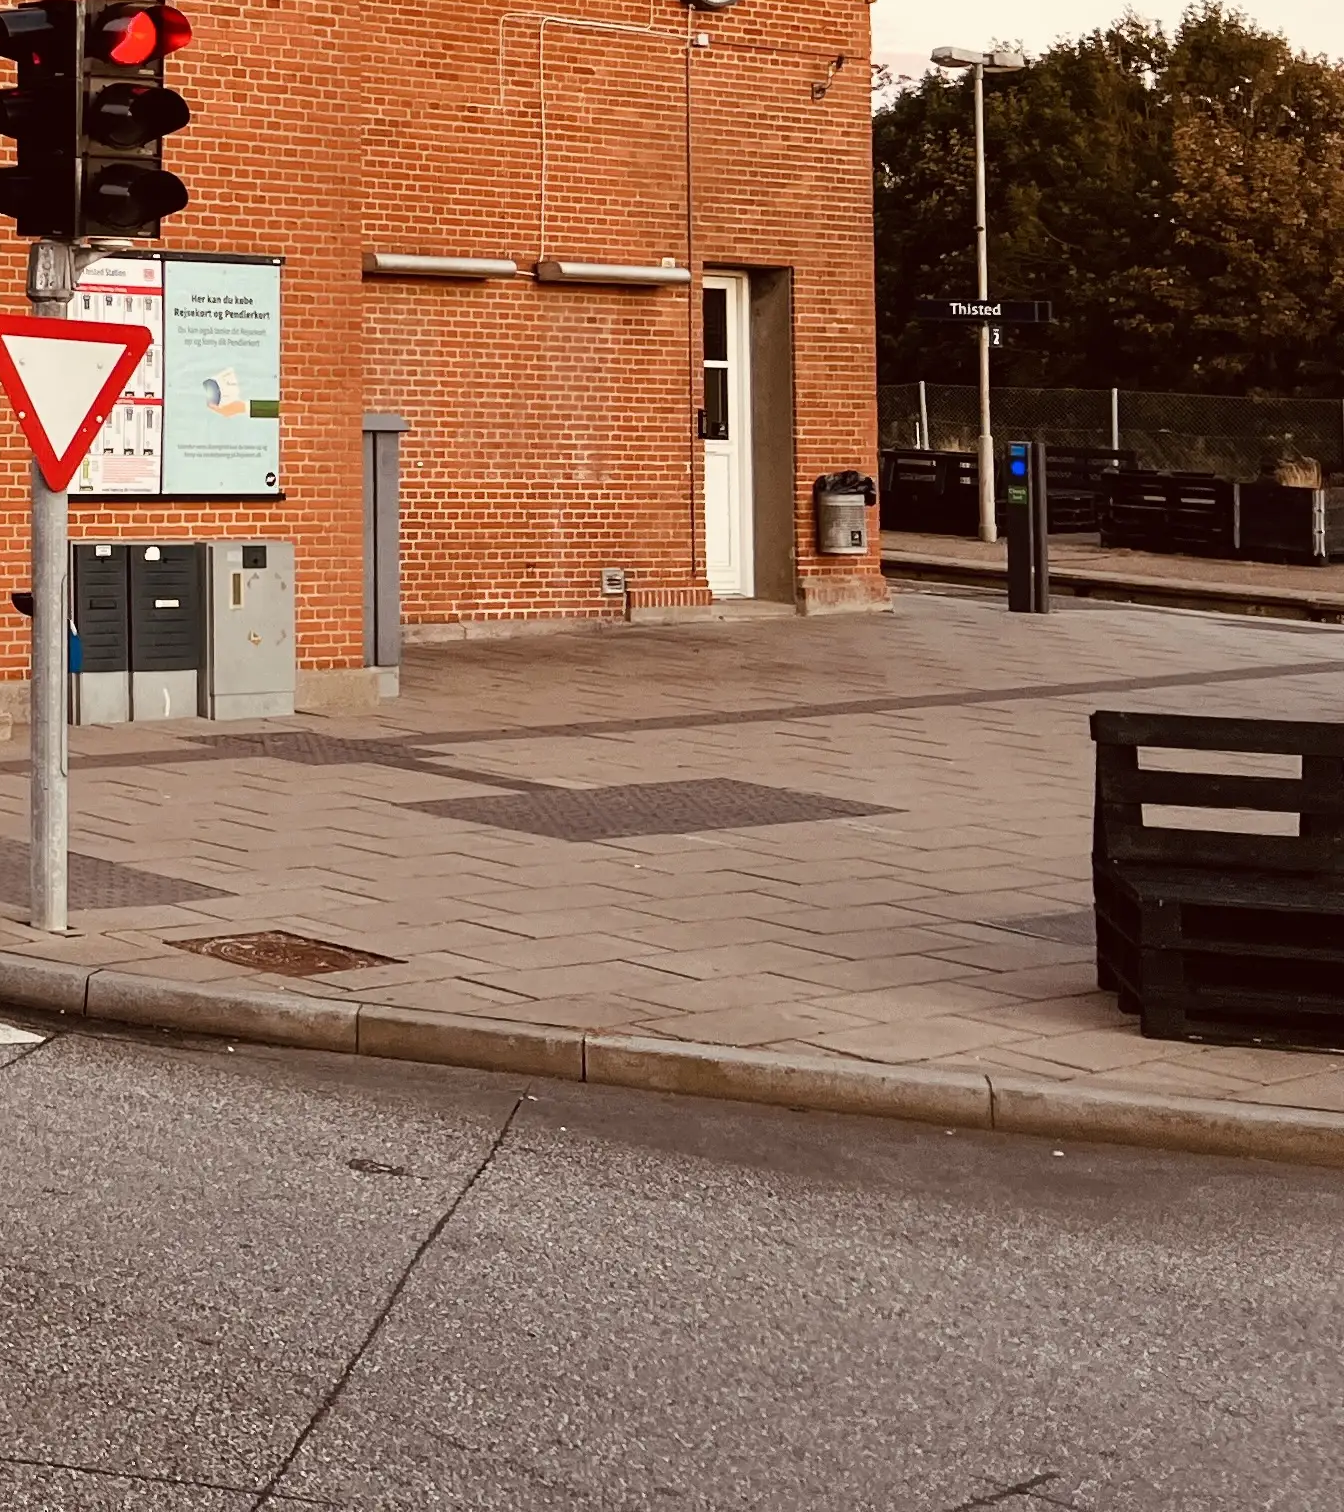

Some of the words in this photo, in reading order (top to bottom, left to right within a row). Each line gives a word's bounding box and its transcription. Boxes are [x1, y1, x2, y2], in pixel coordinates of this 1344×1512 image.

[191, 294, 206, 303] Her
[207, 294, 222, 304] kan
[223, 295, 233, 305] du
[174, 307, 212, 319] Rejsekort
[213, 311, 223, 320] og
[224, 309, 271, 320] Pendlerkort
[949, 302, 1002, 316] Thisted
